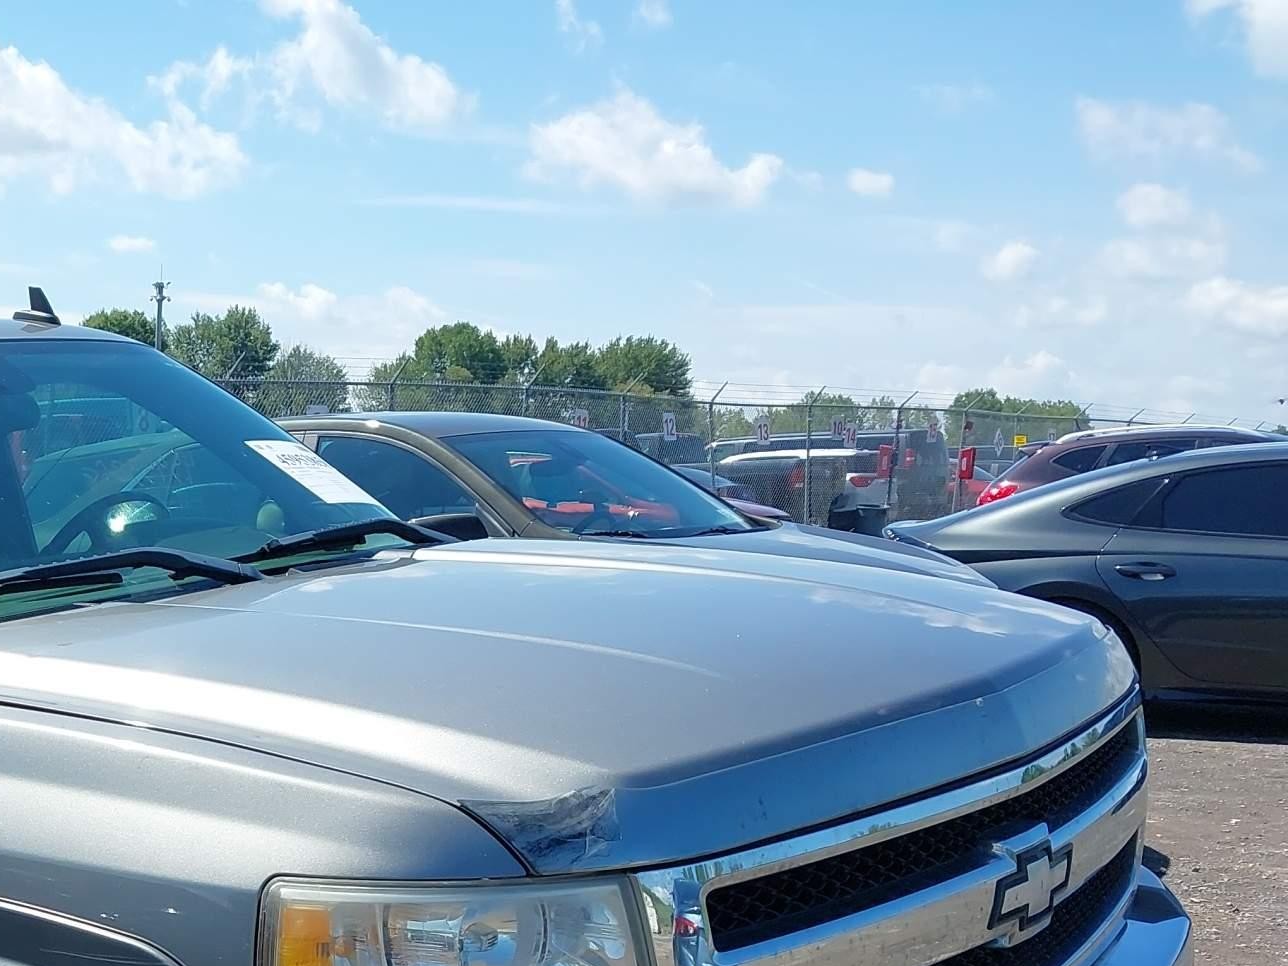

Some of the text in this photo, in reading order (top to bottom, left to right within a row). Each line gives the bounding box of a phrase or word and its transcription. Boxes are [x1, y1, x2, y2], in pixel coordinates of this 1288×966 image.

[664, 417, 676, 436] 12
[757, 423, 769, 441] 13
[846, 427, 857, 444] 14
